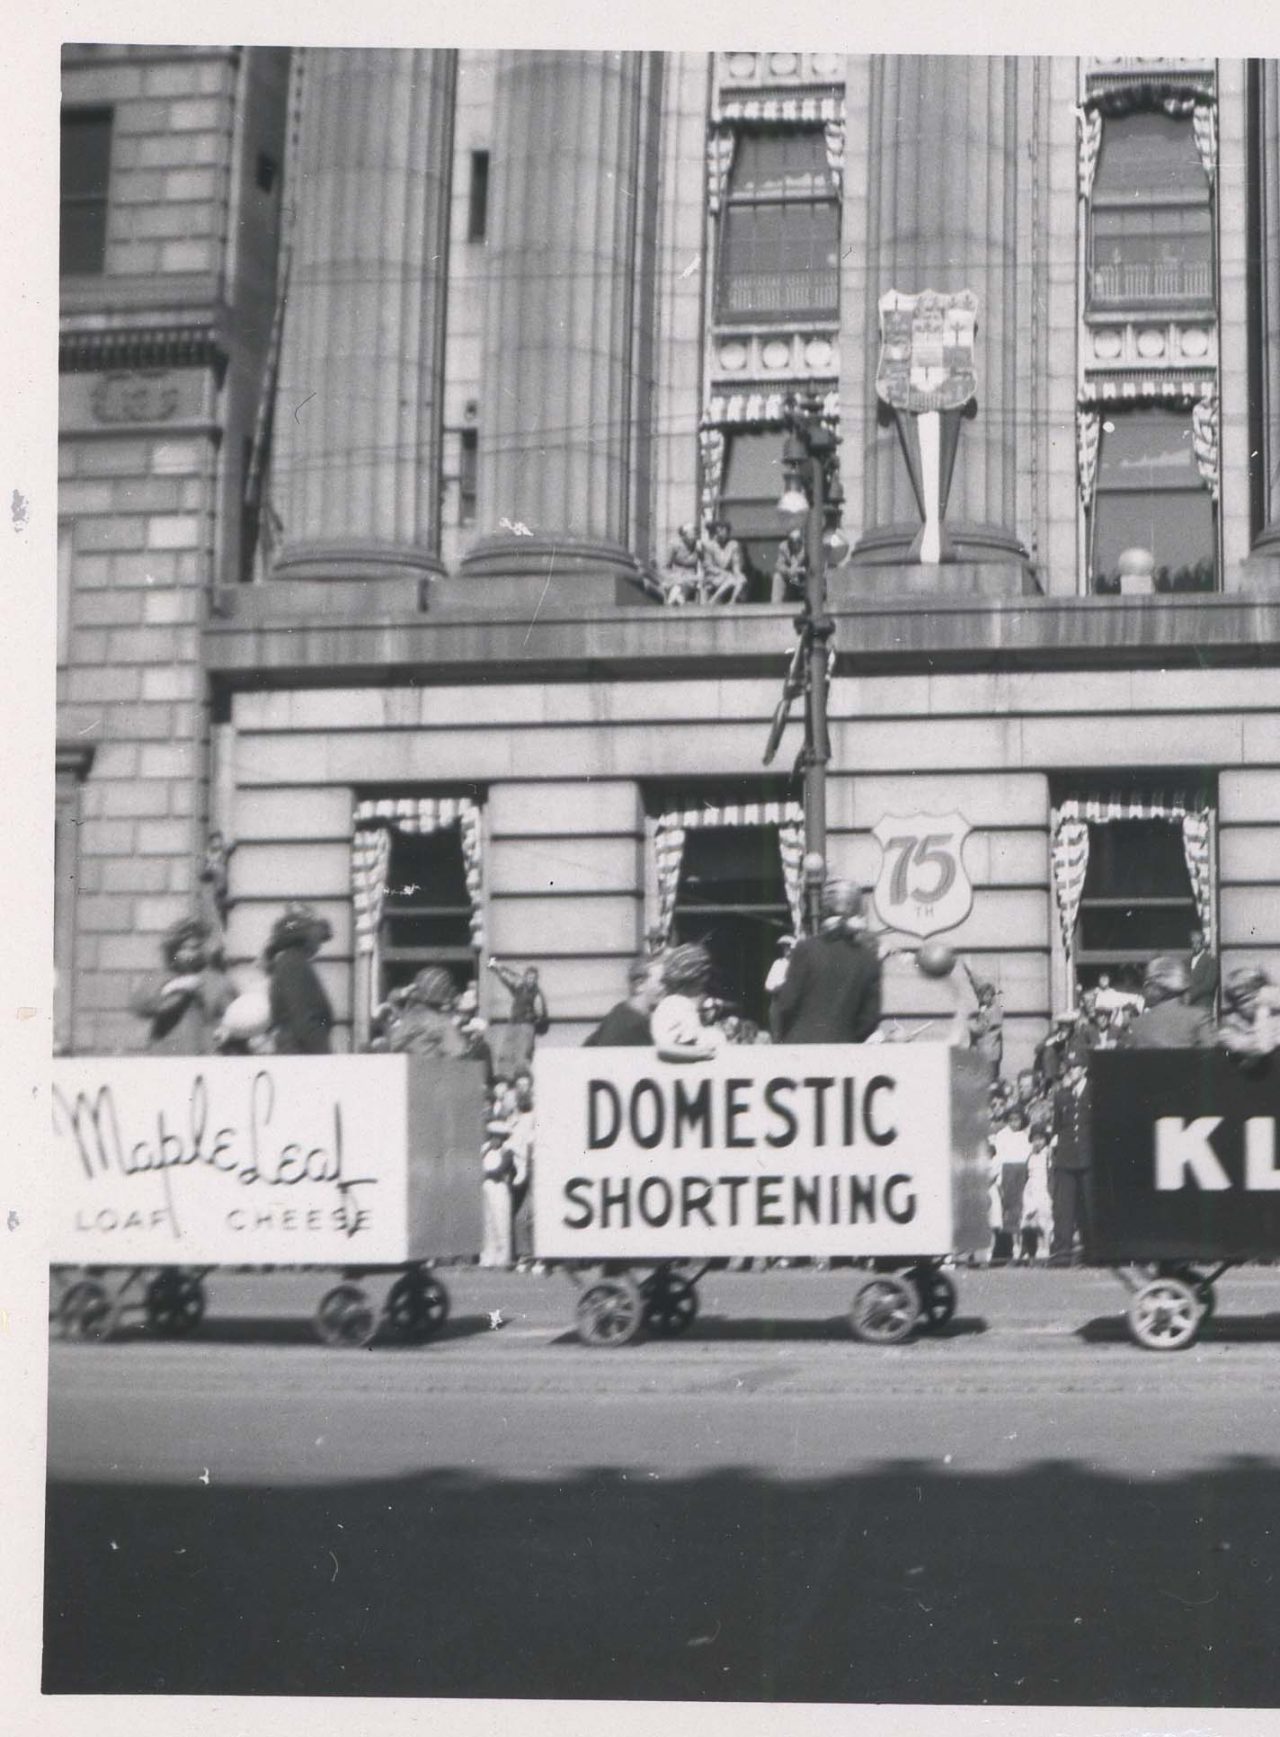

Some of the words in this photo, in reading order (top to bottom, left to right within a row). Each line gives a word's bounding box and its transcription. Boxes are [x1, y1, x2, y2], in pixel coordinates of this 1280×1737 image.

[884, 832, 956, 906] 75
[915, 905, 935, 919] TH
[586, 1075, 899, 1150] DOMESTIC
[51, 1073, 238, 1239] Maple
[238, 1069, 378, 1239] Leaf
[75, 1208, 168, 1233] LOAF
[225, 1207, 374, 1234] CHEESE
[562, 1173, 917, 1229] SHORTENING
